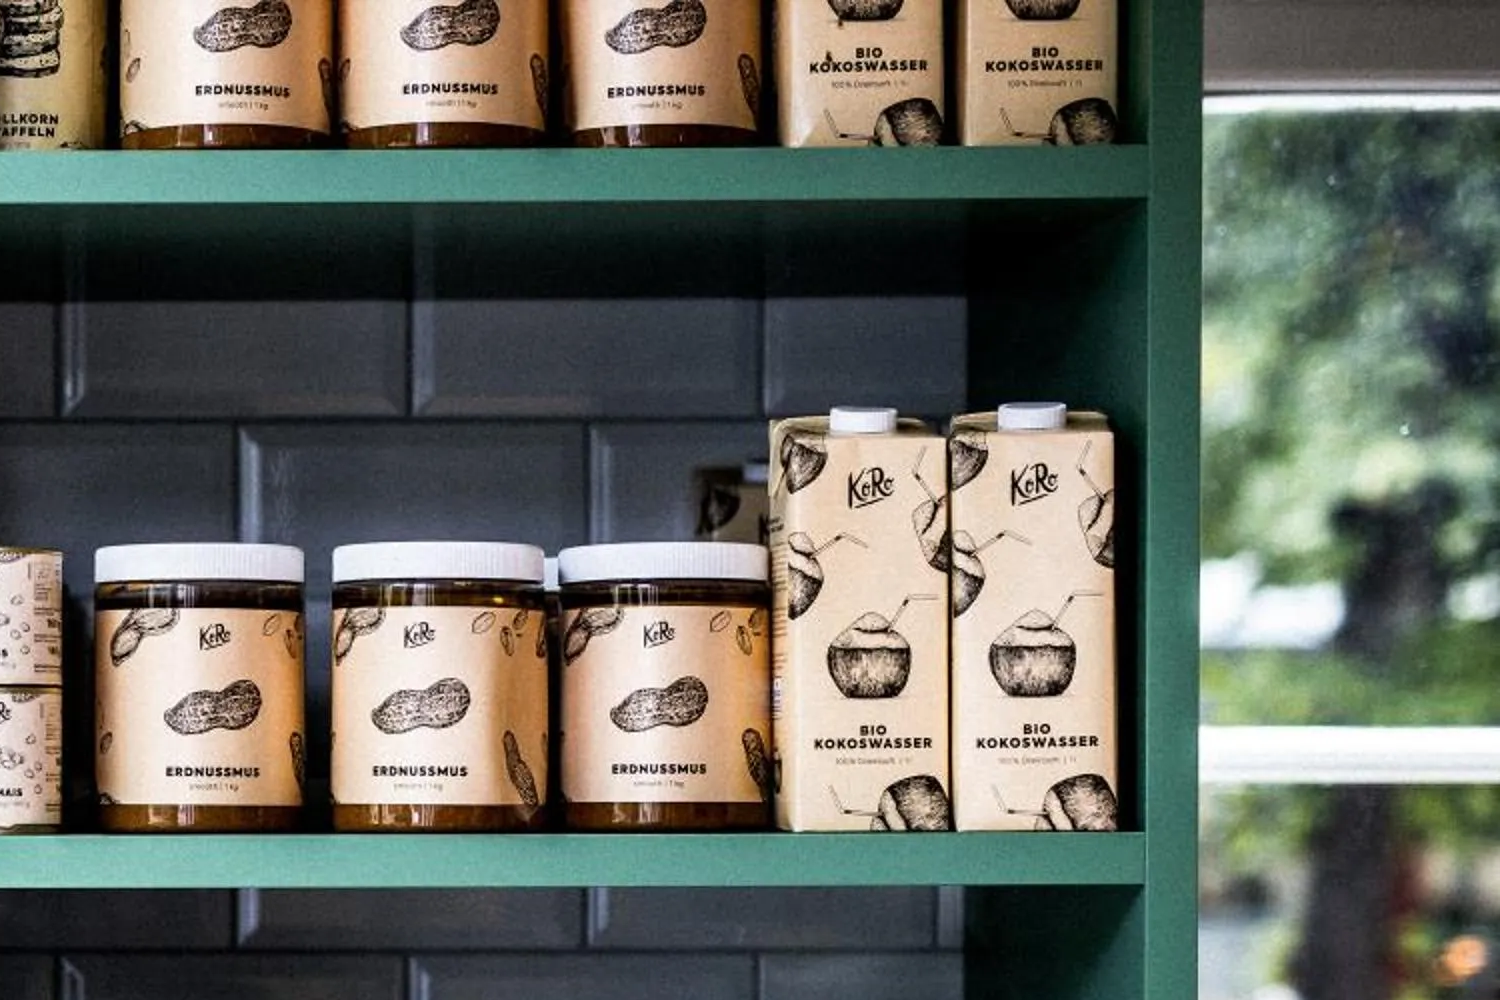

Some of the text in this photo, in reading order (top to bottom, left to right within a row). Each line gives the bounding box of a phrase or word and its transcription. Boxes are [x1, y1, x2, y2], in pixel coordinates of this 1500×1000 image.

[855, 47, 883, 58] BIO
[1031, 47, 1059, 58] BIO
[809, 60, 928, 73] KOKOSWASSER
[984, 59, 1103, 73] KOKOSWASSER
[194, 84, 291, 99] ERDNUSSMUS
[402, 82, 499, 96] ERDNUSSMUS
[607, 84, 706, 98] ERDNUSSMUS
[847, 466, 895, 509] KoRo
[1010, 462, 1059, 506] KoRo
[859, 725, 888, 736] BIO
[1022, 723, 1051, 735] BIO
[813, 736, 933, 750] KOKOSWASSER
[975, 735, 1100, 749] KOKOSWASSER
[165, 766, 260, 778] ERDNUSSMUS
[372, 765, 469, 777] ERDNUSSMUS
[611, 763, 707, 775] ERDNUSSMUS
